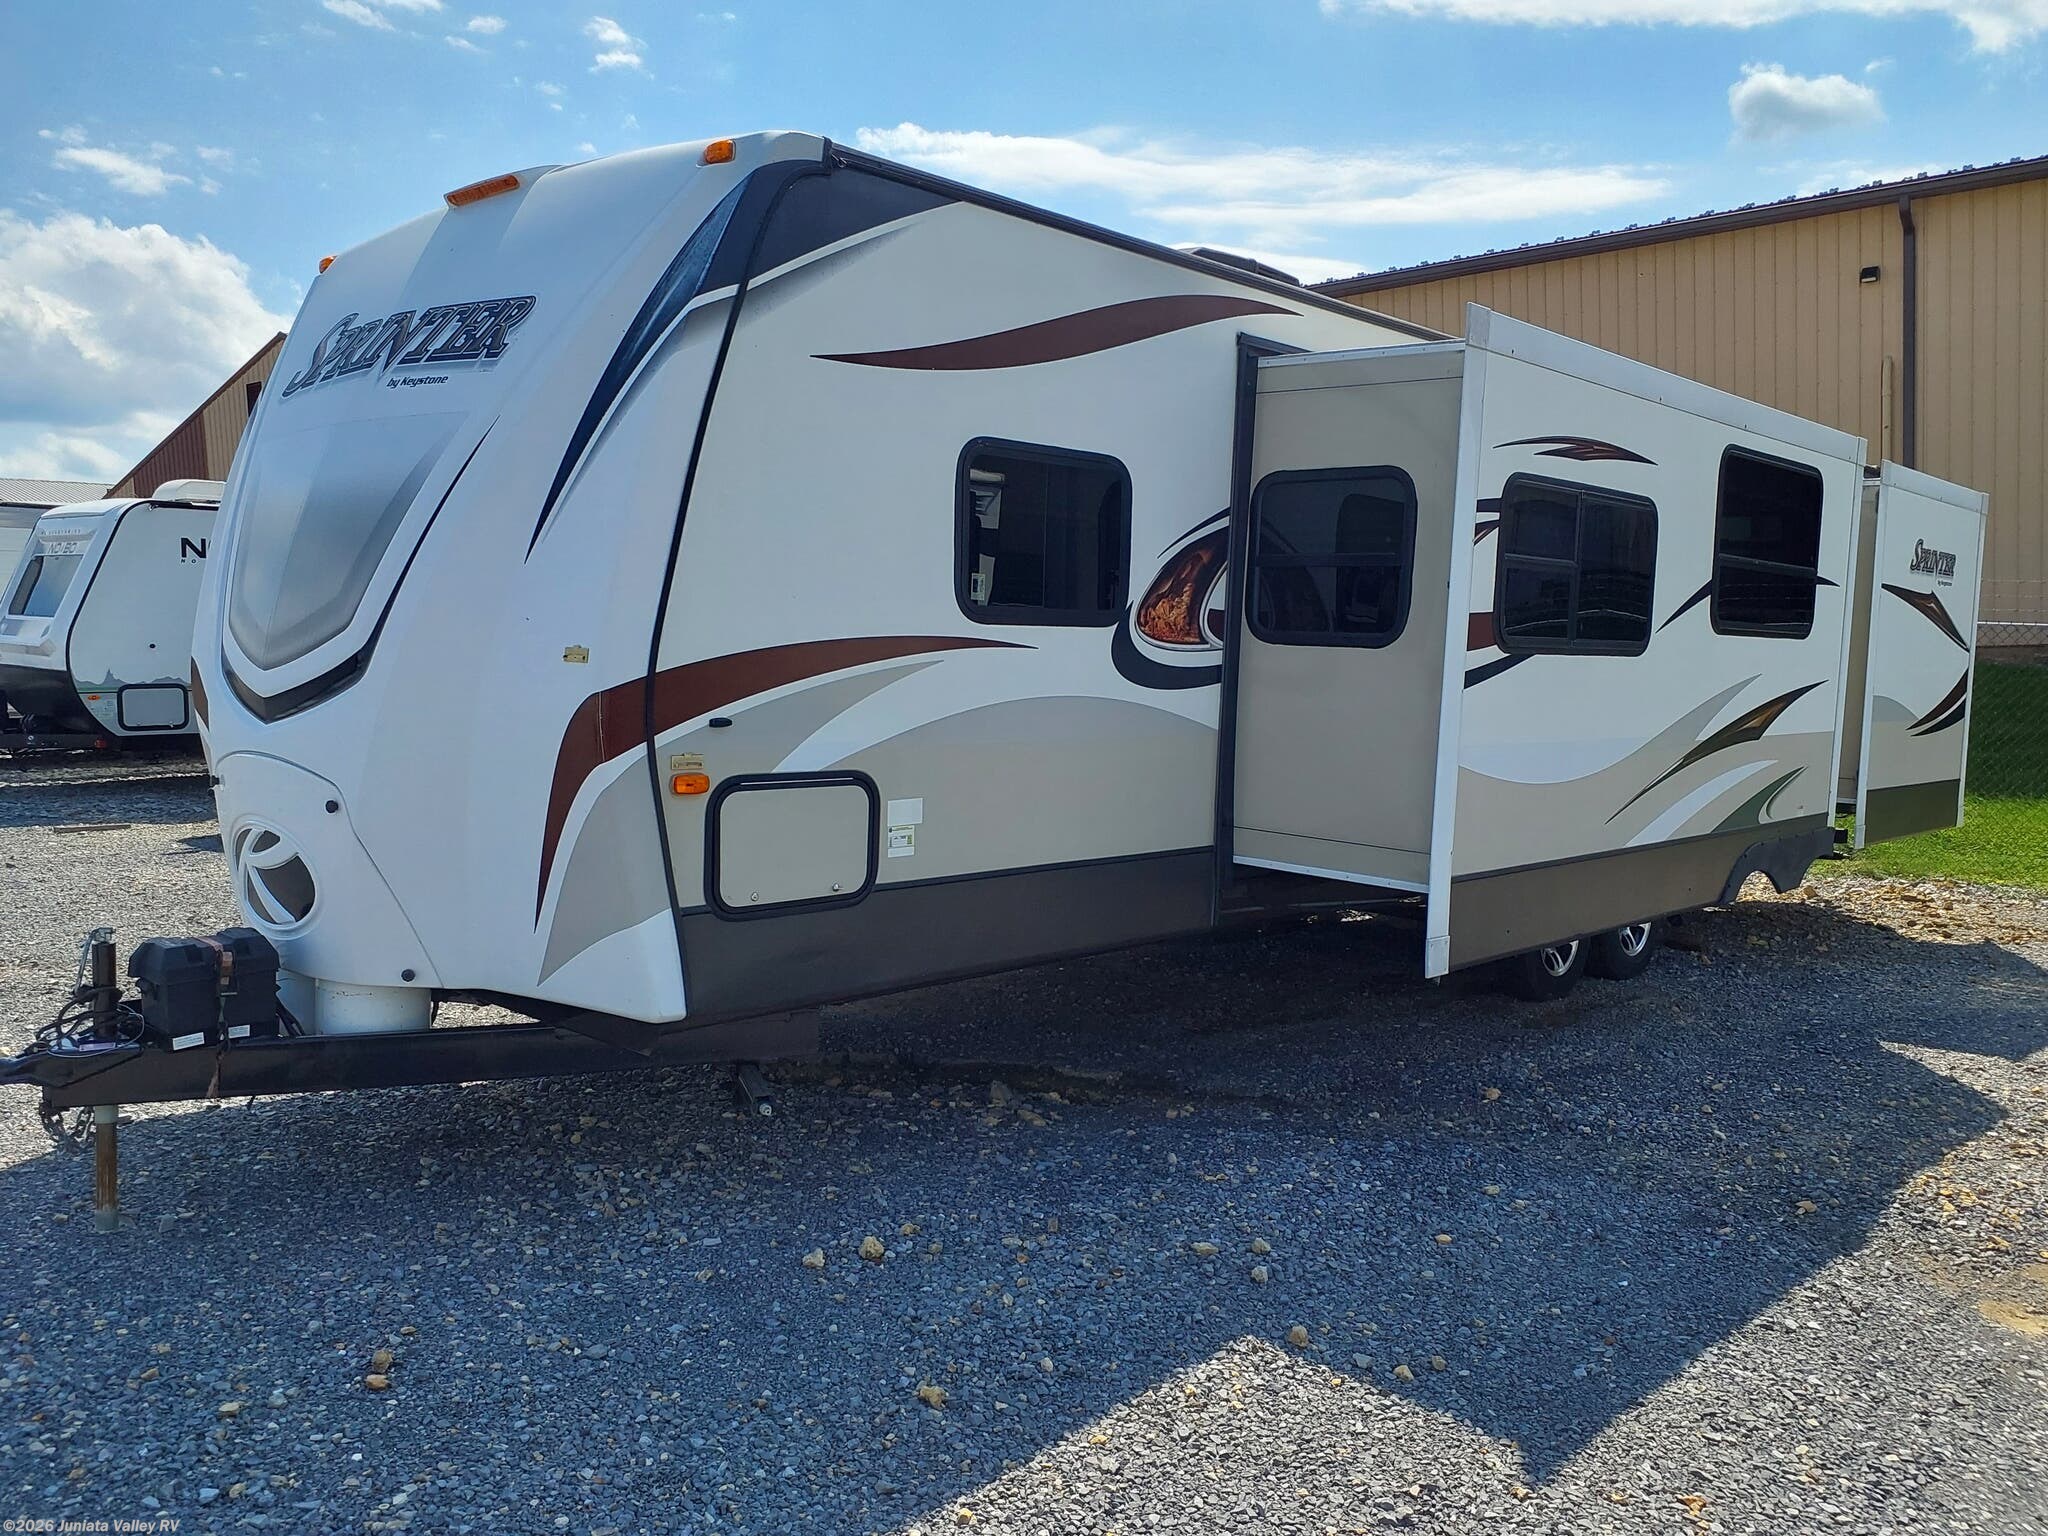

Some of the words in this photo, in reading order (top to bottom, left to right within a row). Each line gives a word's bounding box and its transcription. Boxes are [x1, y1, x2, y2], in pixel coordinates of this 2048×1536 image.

[281, 295, 537, 398] SPRINTER
[386, 377, 400, 389] by
[400, 375, 449, 388] Keystone
